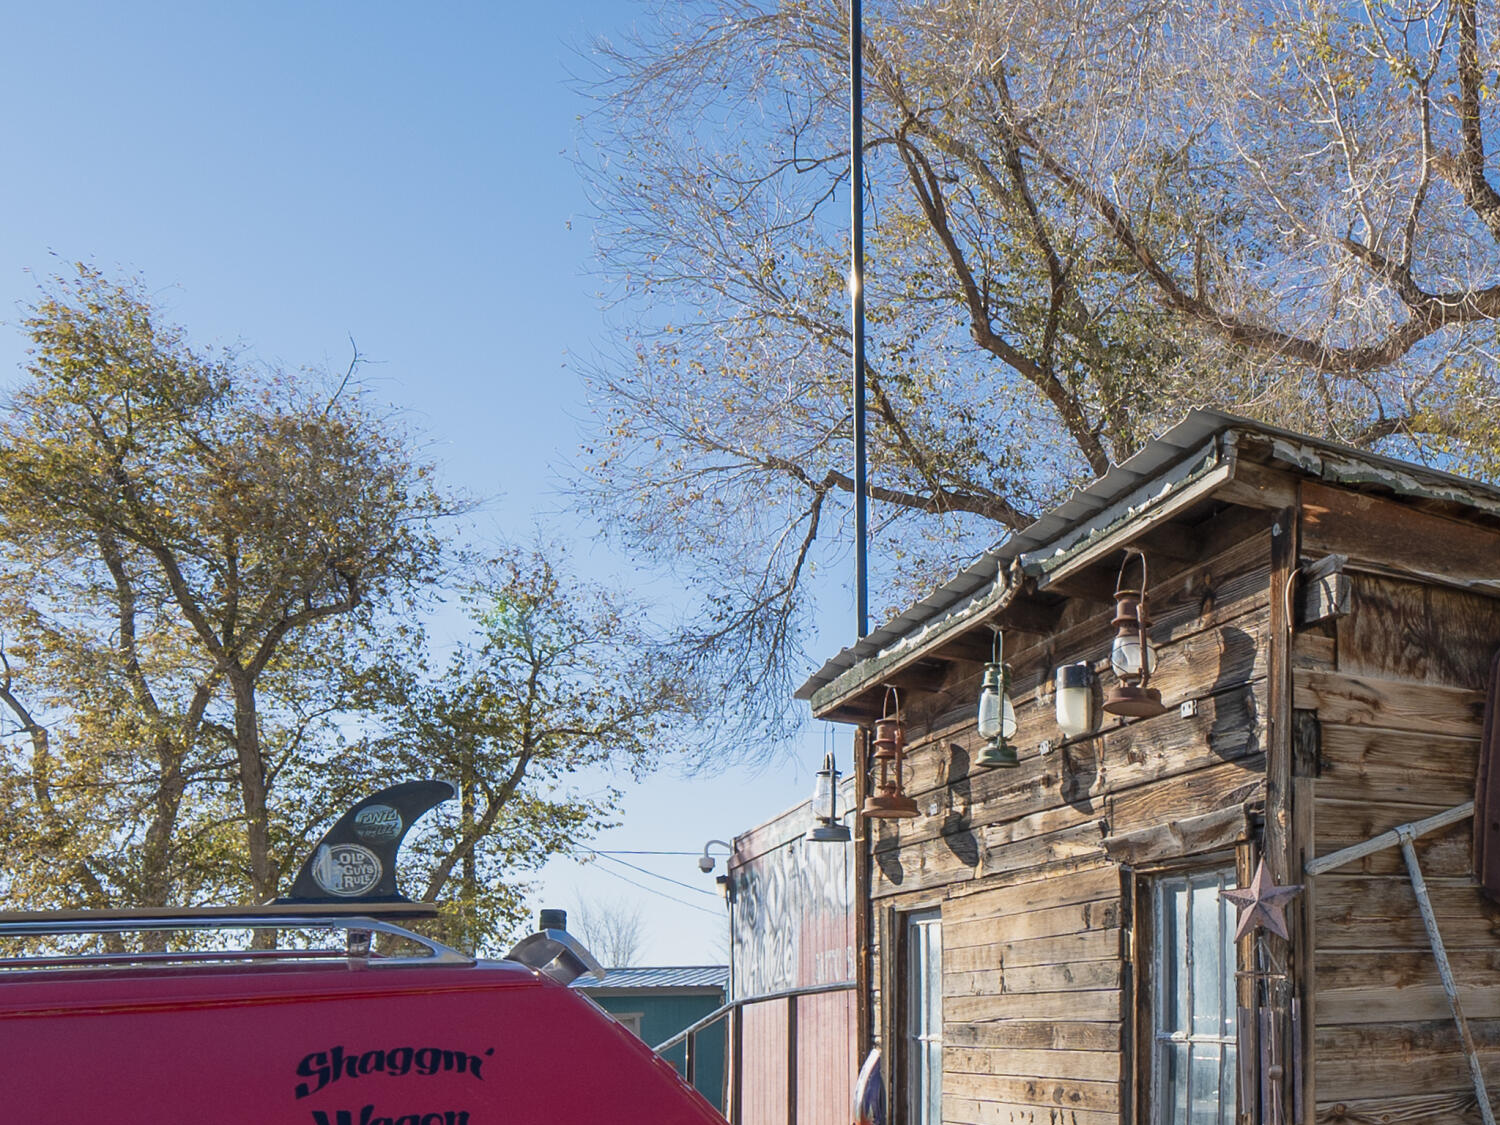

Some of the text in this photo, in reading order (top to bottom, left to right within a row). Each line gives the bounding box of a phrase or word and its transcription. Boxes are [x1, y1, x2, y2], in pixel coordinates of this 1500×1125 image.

[339, 853, 365, 865] OLD
[344, 864, 374, 877] GUYS
[344, 875, 370, 889] RULE
